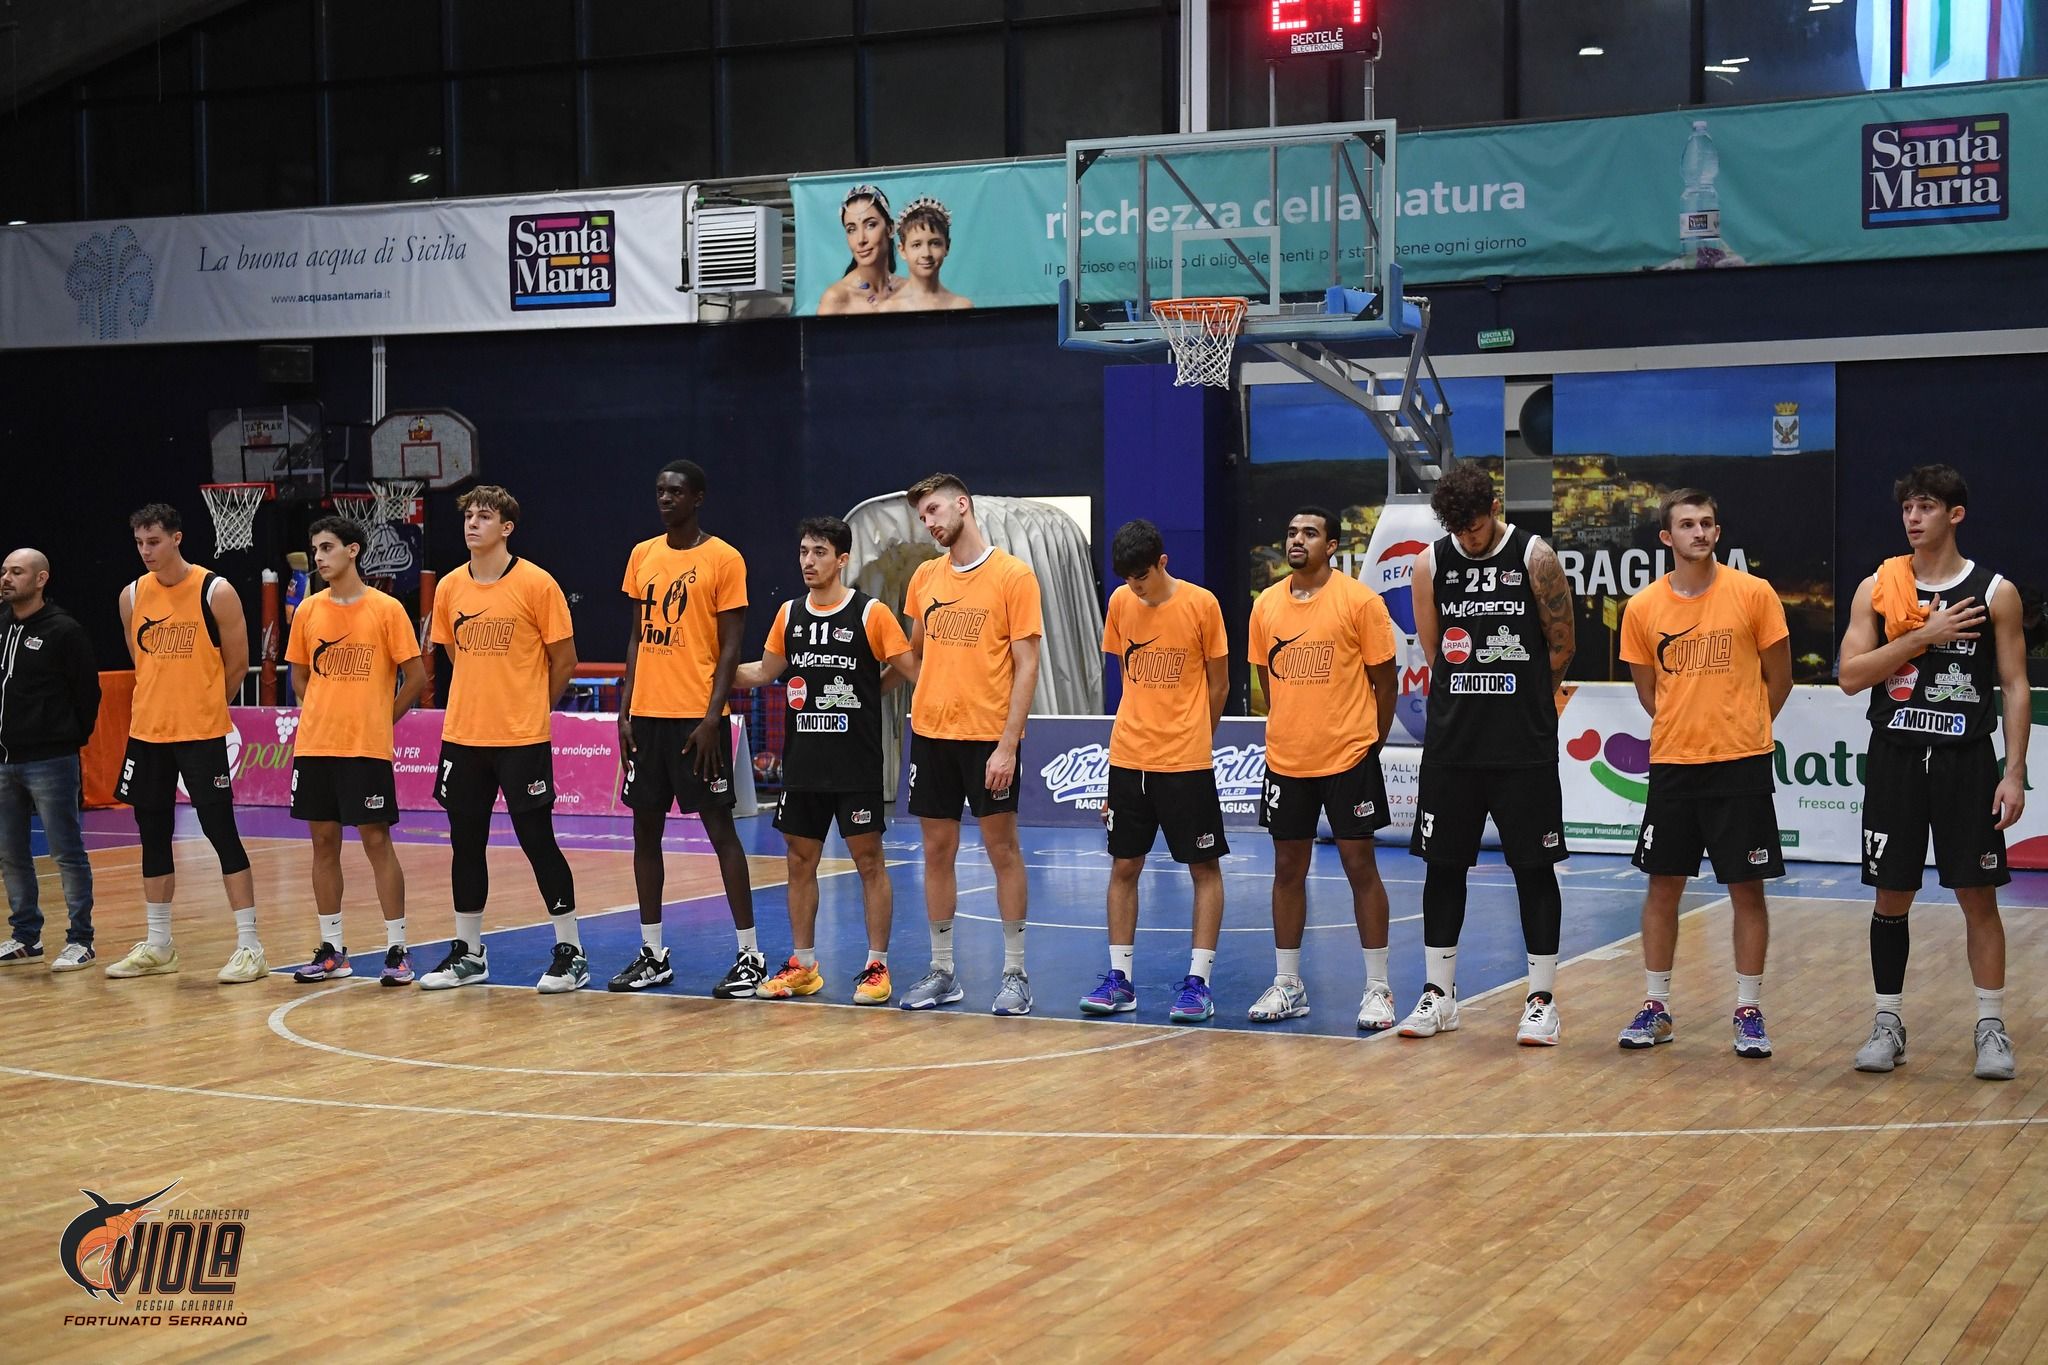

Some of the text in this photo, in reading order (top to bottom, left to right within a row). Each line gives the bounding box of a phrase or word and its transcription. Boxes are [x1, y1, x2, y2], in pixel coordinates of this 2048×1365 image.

[1291, 43, 1343, 54] ELECTRONICS
[1872, 126, 2001, 169] Santa
[1869, 165, 2001, 210] Maria
[516, 220, 610, 256] Santa
[197, 234, 467, 276] La buona acqua di Sicilia
[1056, 261, 1115, 277] pzioso
[1191, 254, 1205, 267] di
[1320, 248, 1344, 262] pr
[1434, 237, 1470, 257] ogni
[1474, 236, 1527, 255] giorno
[514, 255, 611, 294] Maria
[271, 289, 391, 304] www.acquasantamaria.it
[1465, 567, 1498, 593] 23
[809, 622, 829, 645] 11
[404, 747, 420, 758] PER
[562, 744, 611, 758] enologiche
[123, 758, 136, 783] 5
[442, 759, 453, 782] 7
[1221, 788, 1247, 796] KLEB
[1798, 796, 1846, 810] fresca
[1075, 798, 1105, 810] RAGU
[1220, 803, 1256, 814] AGUSA
[1643, 824, 1655, 850] 4
[1781, 833, 1797, 842] 2023
[1863, 829, 1889, 860] 37
